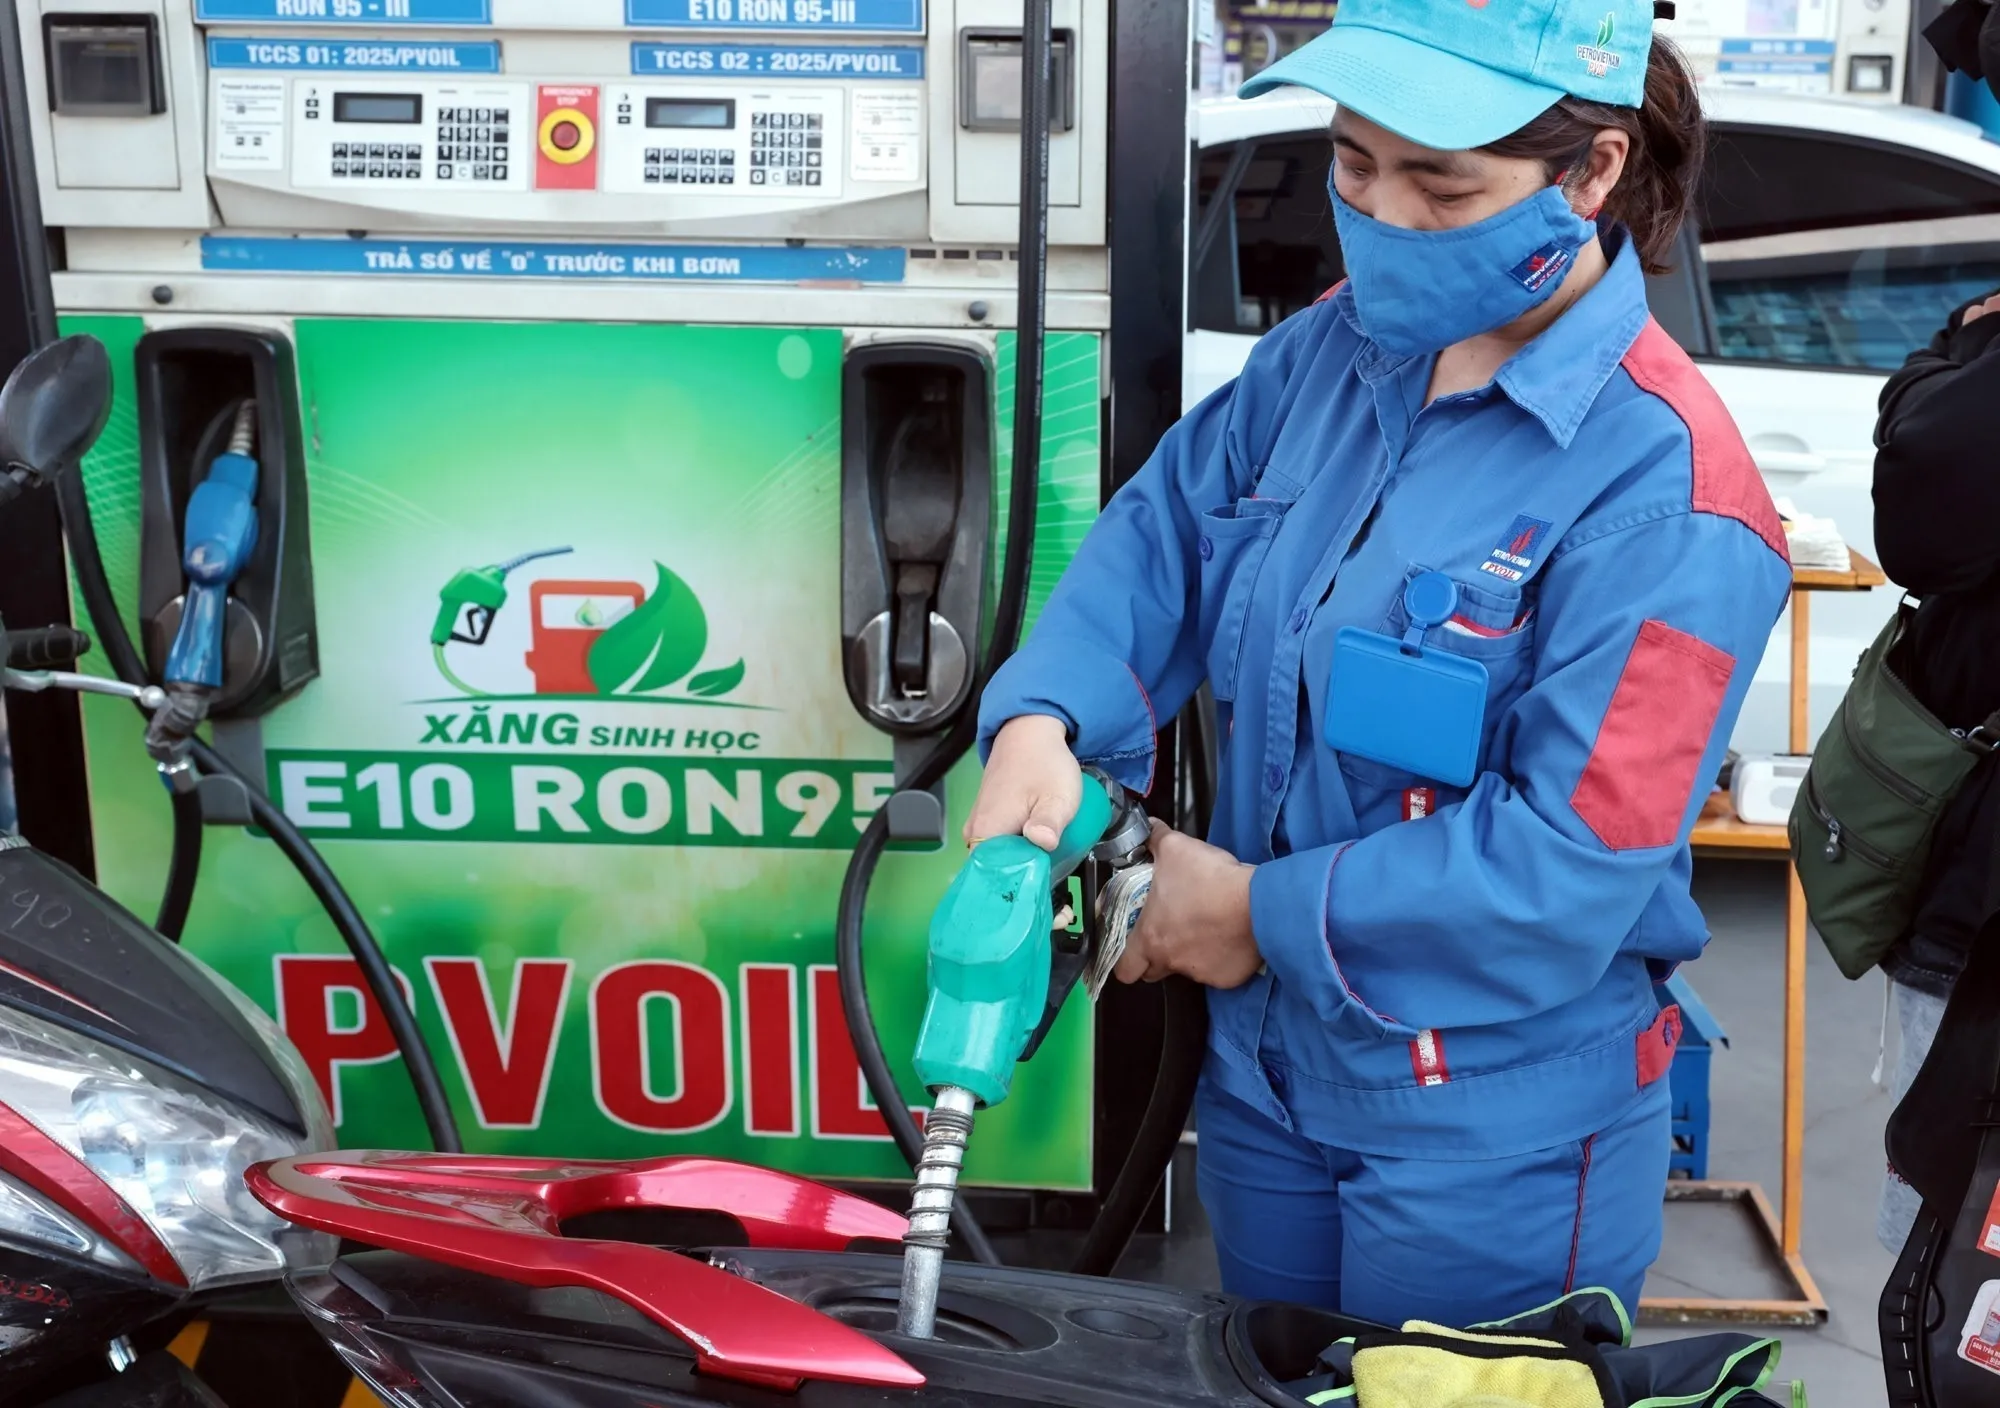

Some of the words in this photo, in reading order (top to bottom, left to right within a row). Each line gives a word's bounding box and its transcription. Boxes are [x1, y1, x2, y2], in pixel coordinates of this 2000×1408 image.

[688, 0, 732, 20] E10
[738, 0, 787, 22] RON
[794, 0, 856, 23] 95-III
[246, 44, 300, 64] TCCS
[306, 46, 338, 65] 01:
[344, 46, 461, 67] 2025/PVOIL
[653, 50, 714, 70] TCCS
[720, 51, 750, 70] 02
[770, 52, 902, 73] 2025/PVOIL
[1576, 45, 1621, 69] PETROVIETNAM
[364, 245, 414, 269] TRẢ
[420, 247, 454, 269] SỐ
[543, 251, 626, 273] TRƯỚC
[632, 256, 675, 274] KHI
[682, 256, 741, 274] BƠM
[1485, 563, 1516, 580] PVOIL
[418, 705, 580, 746] XĂNG
[589, 726, 676, 748] SINH
[684, 729, 761, 754] HỌC
[279, 760, 475, 832] E10
[273, 953, 930, 1142] PVOIL
